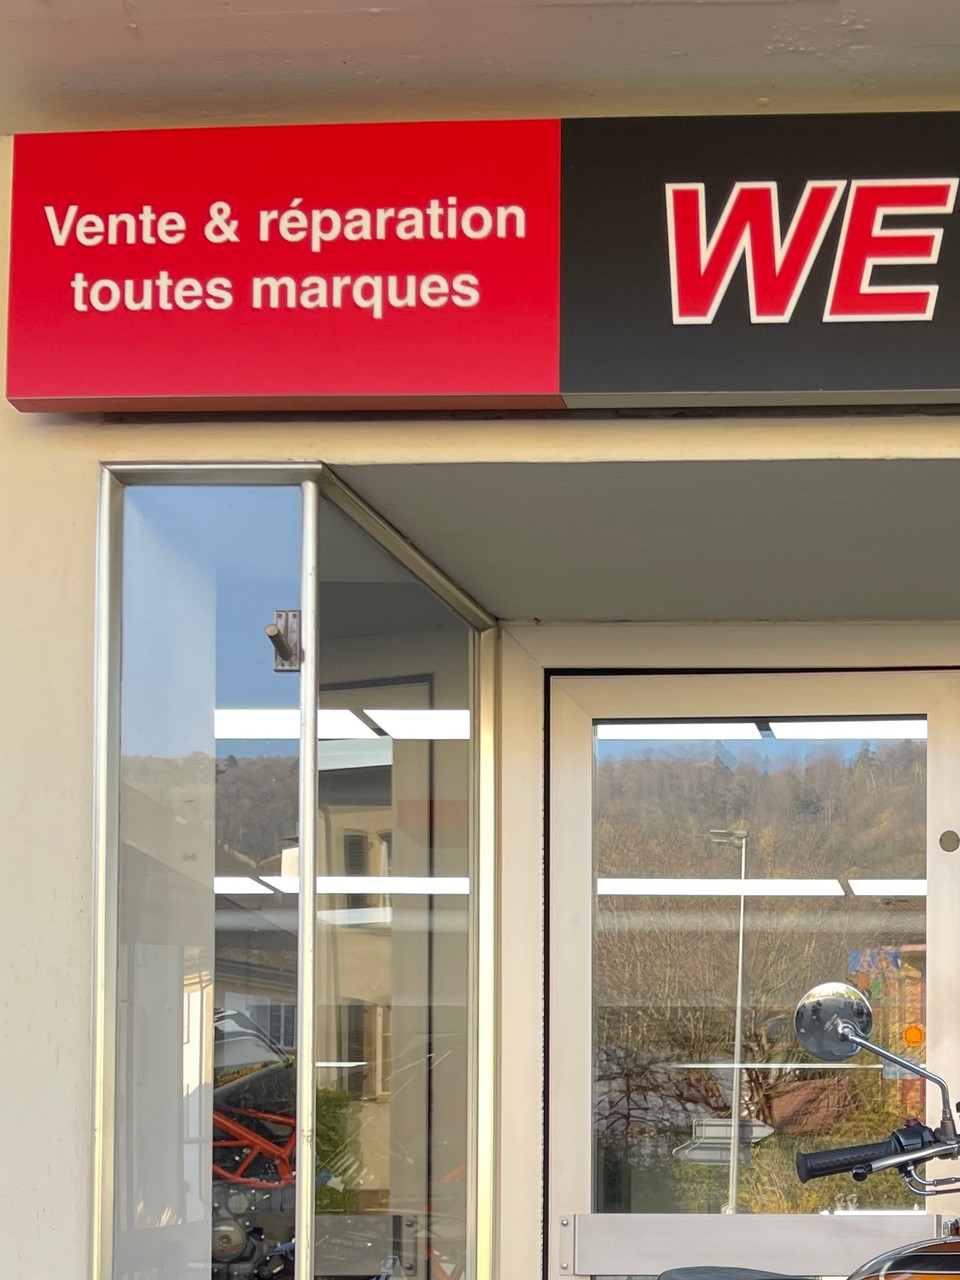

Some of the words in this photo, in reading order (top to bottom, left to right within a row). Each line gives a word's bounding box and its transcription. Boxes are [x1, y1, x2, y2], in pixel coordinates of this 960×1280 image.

[44, 205, 186, 246] Vente
[204, 201, 240, 243] &
[259, 197, 526, 253] réparation
[71, 271, 234, 312] toutes
[252, 273, 480, 319] marques
